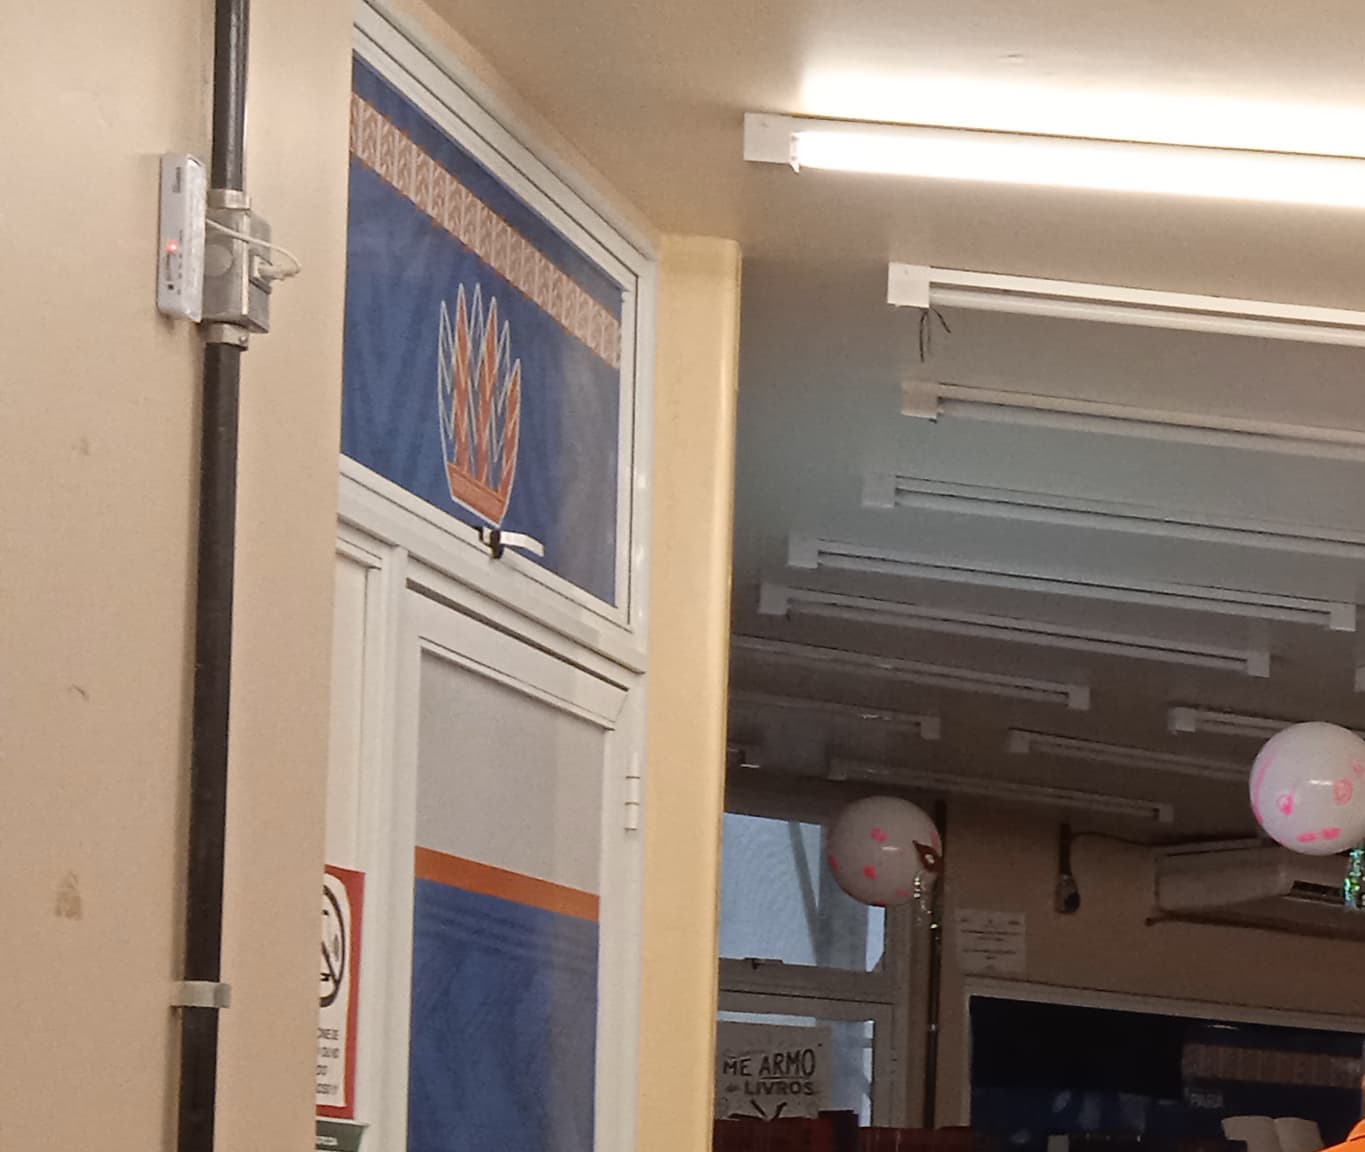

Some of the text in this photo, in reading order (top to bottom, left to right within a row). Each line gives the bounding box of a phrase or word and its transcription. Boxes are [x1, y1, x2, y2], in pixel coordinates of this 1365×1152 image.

[723, 1048, 816, 1077] ME ARMO
[744, 1080, 816, 1096] LIVROS
